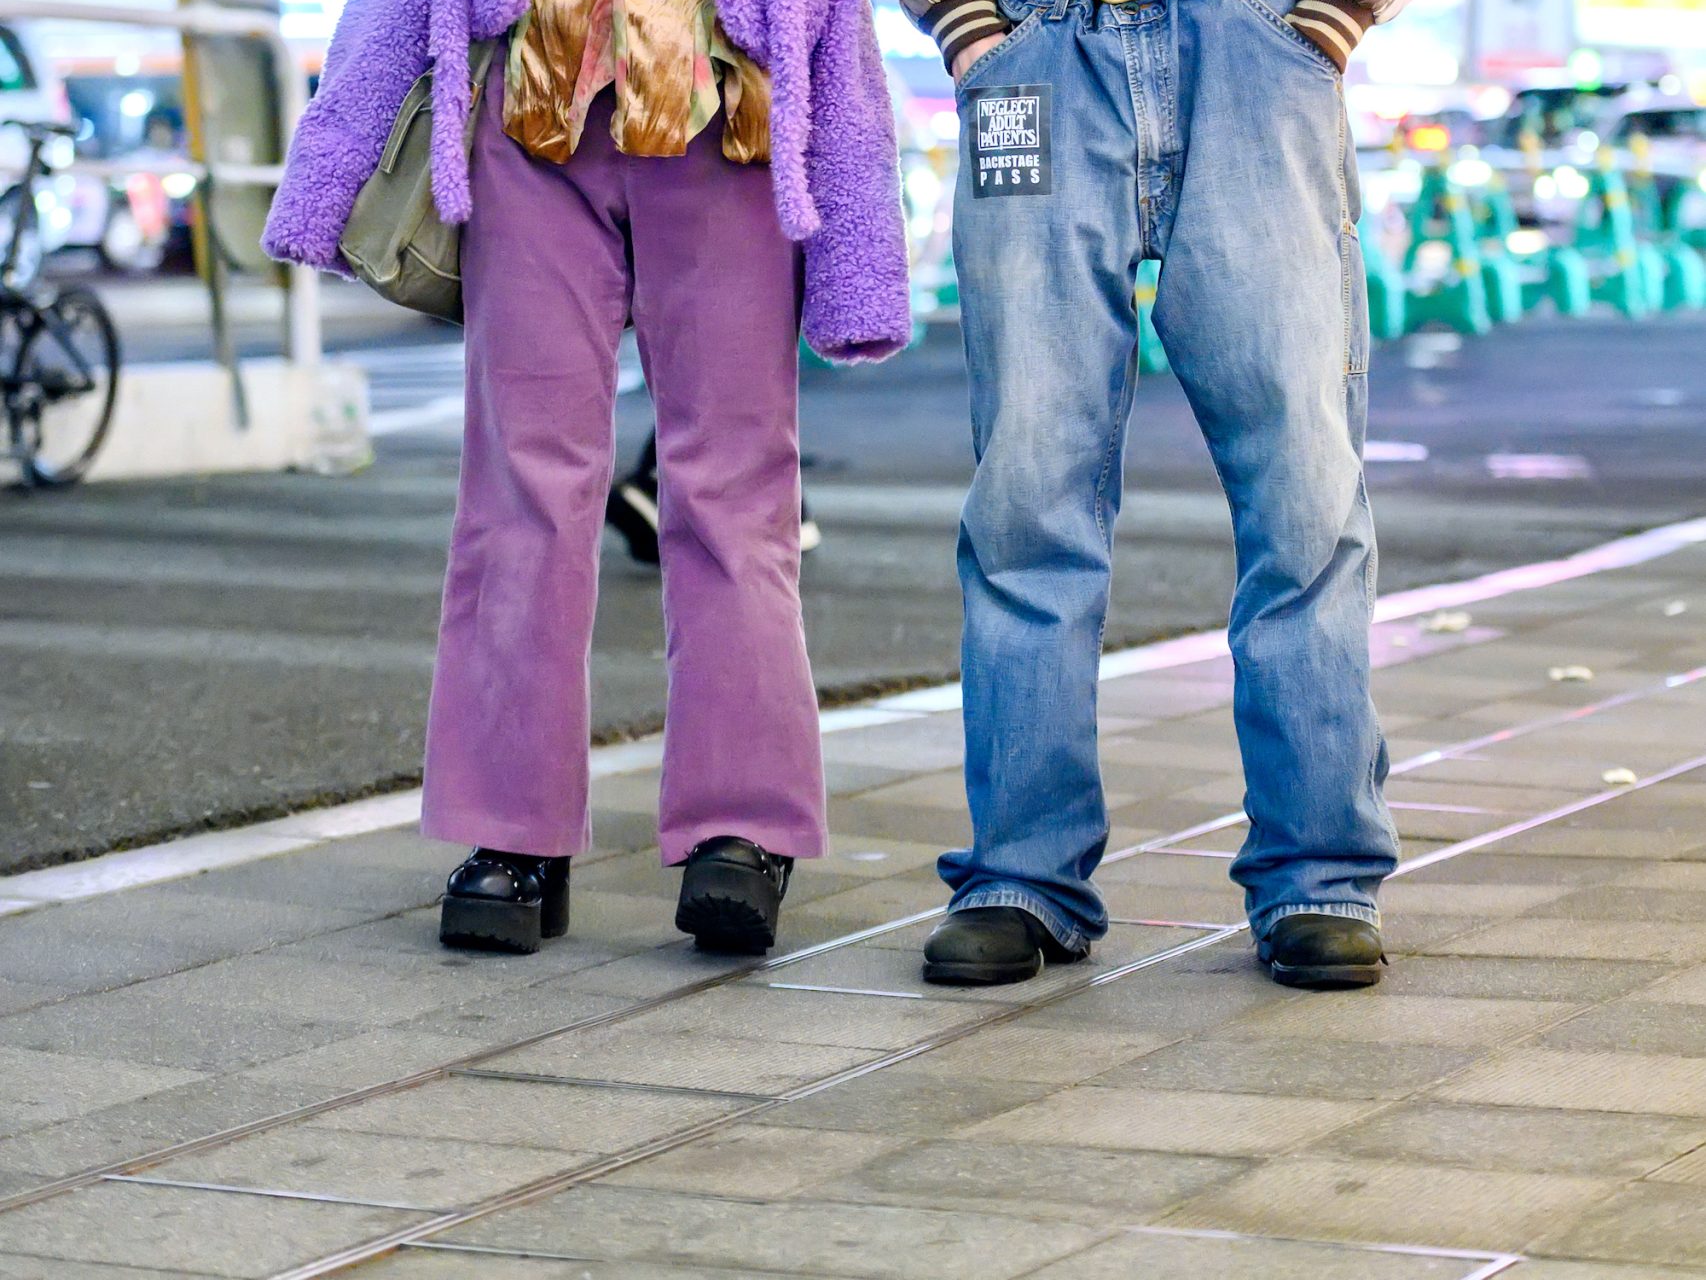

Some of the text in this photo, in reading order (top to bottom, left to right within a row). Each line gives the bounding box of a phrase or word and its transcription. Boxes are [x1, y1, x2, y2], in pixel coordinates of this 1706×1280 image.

[981, 100, 1035, 116] NEGLECT
[988, 115, 1027, 132] ADULT
[980, 129, 1036, 148] PATIENTS
[980, 154, 1040, 170] BACKSTAGE
